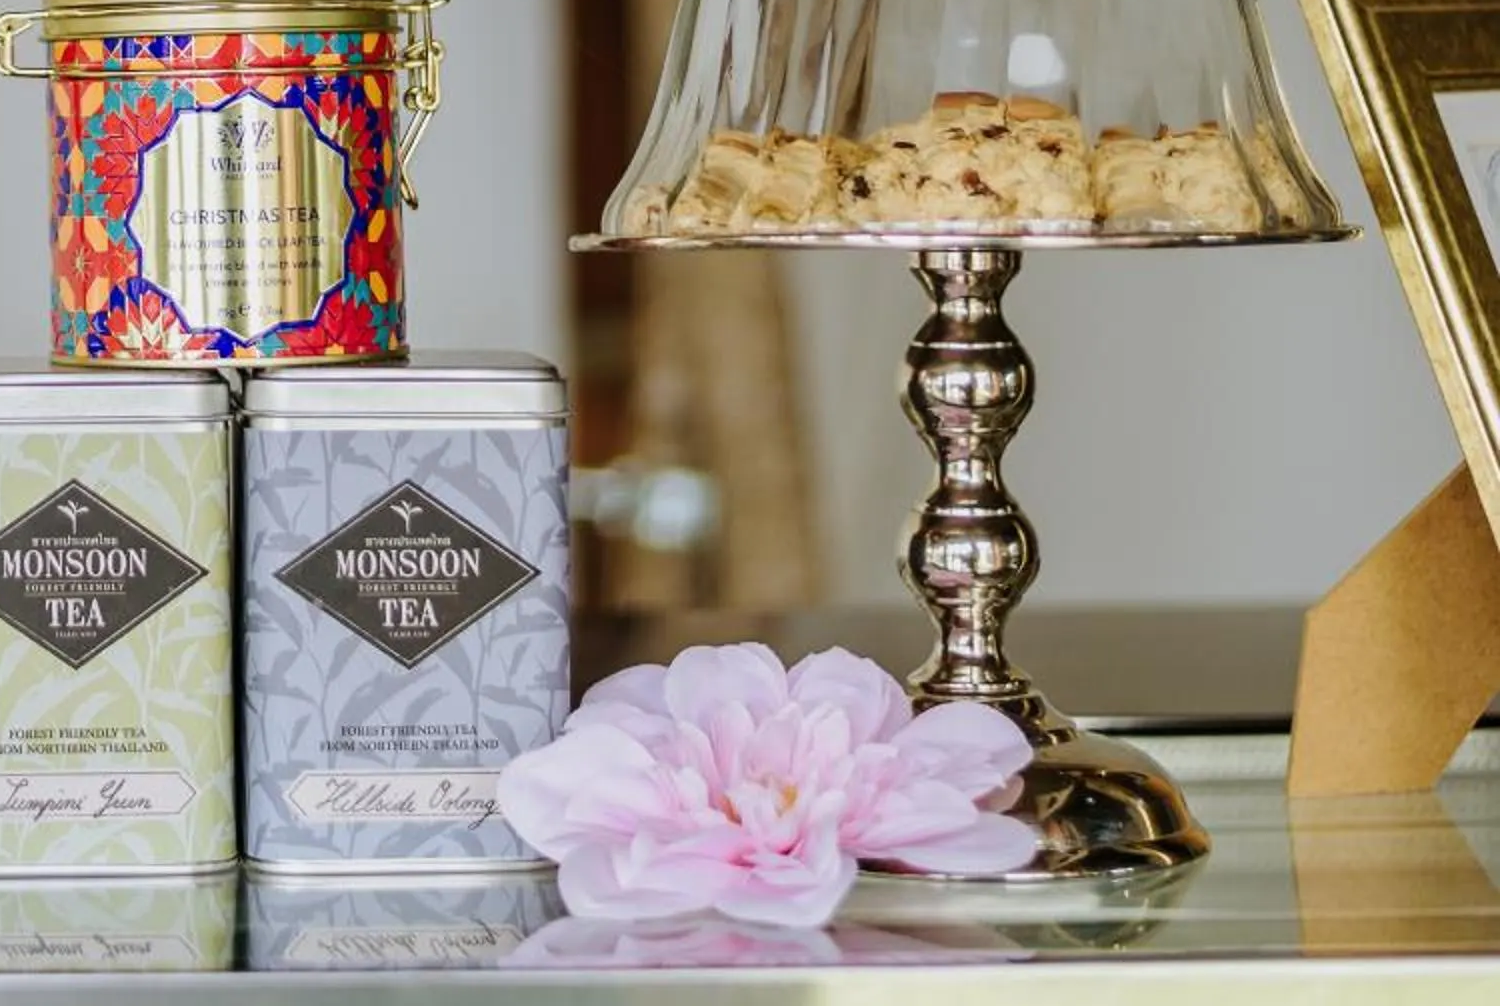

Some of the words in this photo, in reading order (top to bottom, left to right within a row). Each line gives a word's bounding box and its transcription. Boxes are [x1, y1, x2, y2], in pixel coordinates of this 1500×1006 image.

[211, 155, 283, 173] Whiard
[288, 206, 320, 223] TEA
[1, 548, 148, 579] MONSOON
[335, 548, 481, 579] MONSOON
[45, 597, 106, 628] TEA
[378, 597, 439, 628] TEA
[9, 727, 55, 739] FOREST
[59, 727, 119, 738] FRIENDLY
[123, 726, 148, 738] TEA
[341, 725, 385, 737] FOREST
[389, 725, 450, 737] FRIENDLY
[454, 724, 478, 736] TEA
[26, 742, 97, 754] NORTHERN
[101, 741, 167, 753] THAILAND
[320, 741, 355, 752] FROM
[359, 740, 429, 752] NORTHERN
[433, 739, 499, 751] THAILAND
[316, 778, 416, 814] Hillside
